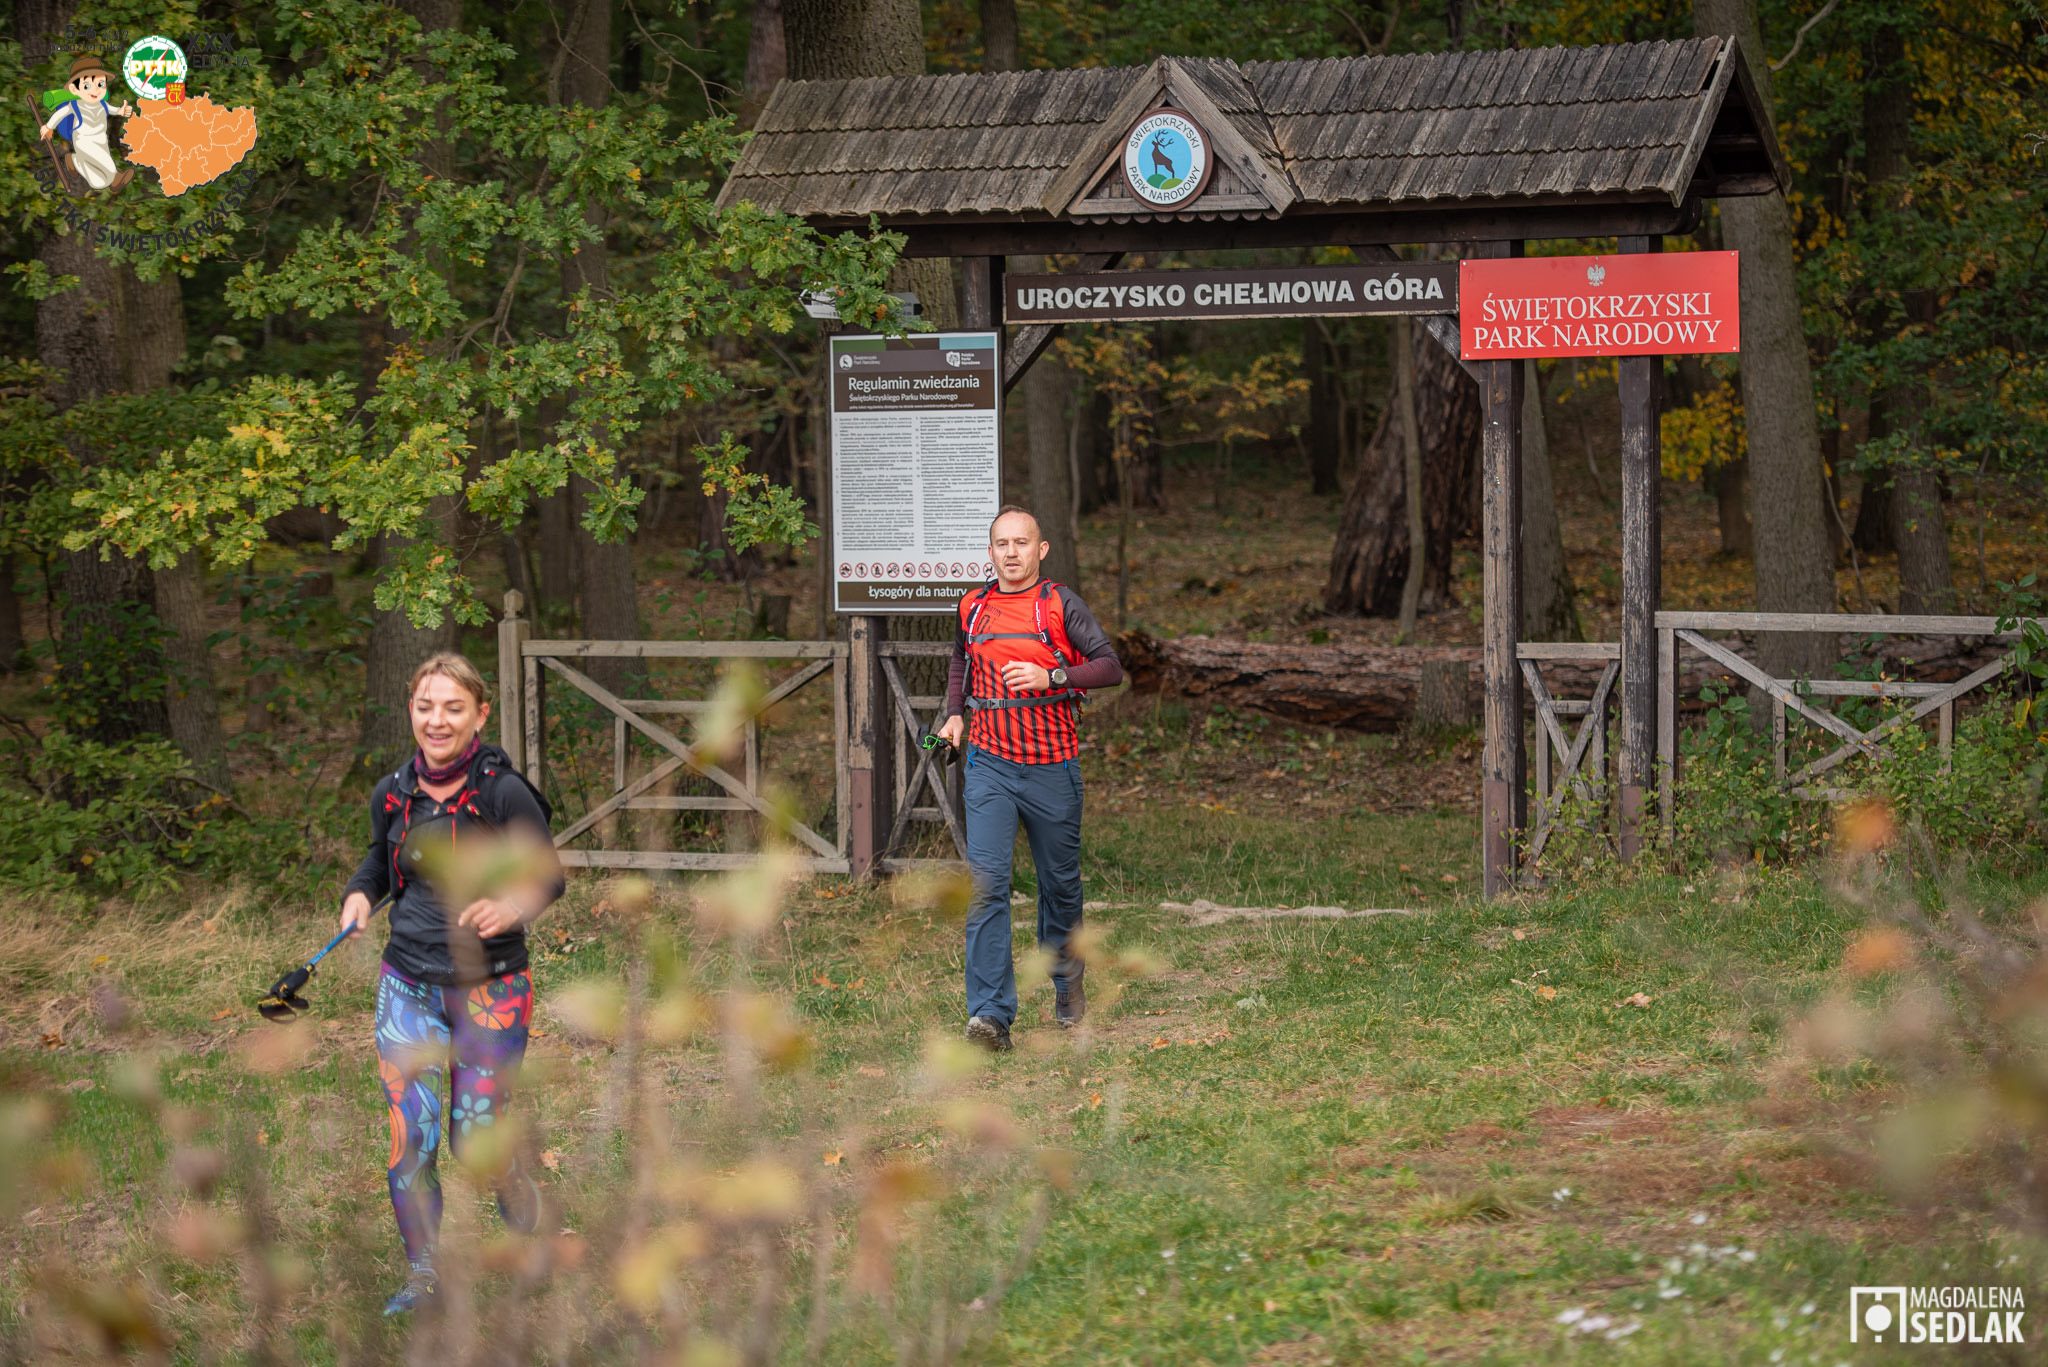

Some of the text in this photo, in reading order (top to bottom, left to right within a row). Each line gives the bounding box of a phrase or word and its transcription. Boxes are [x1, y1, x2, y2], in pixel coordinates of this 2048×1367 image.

[1129, 166, 1201, 202] PARK NARODOWY
[1017, 272, 1445, 310] UROCZYSKO CHEŁMOWA GÓRA
[1482, 290, 1712, 328] ŚWIĘTOKRZYSKI
[1473, 319, 1723, 349] PARK NARODOWY
[848, 374, 980, 393] Regulamin zwiedzania
[901, 392, 919, 401] Parku
[919, 391, 958, 402] Narodowego
[868, 585, 913, 600] Łysogóry
[915, 585, 931, 597] dla
